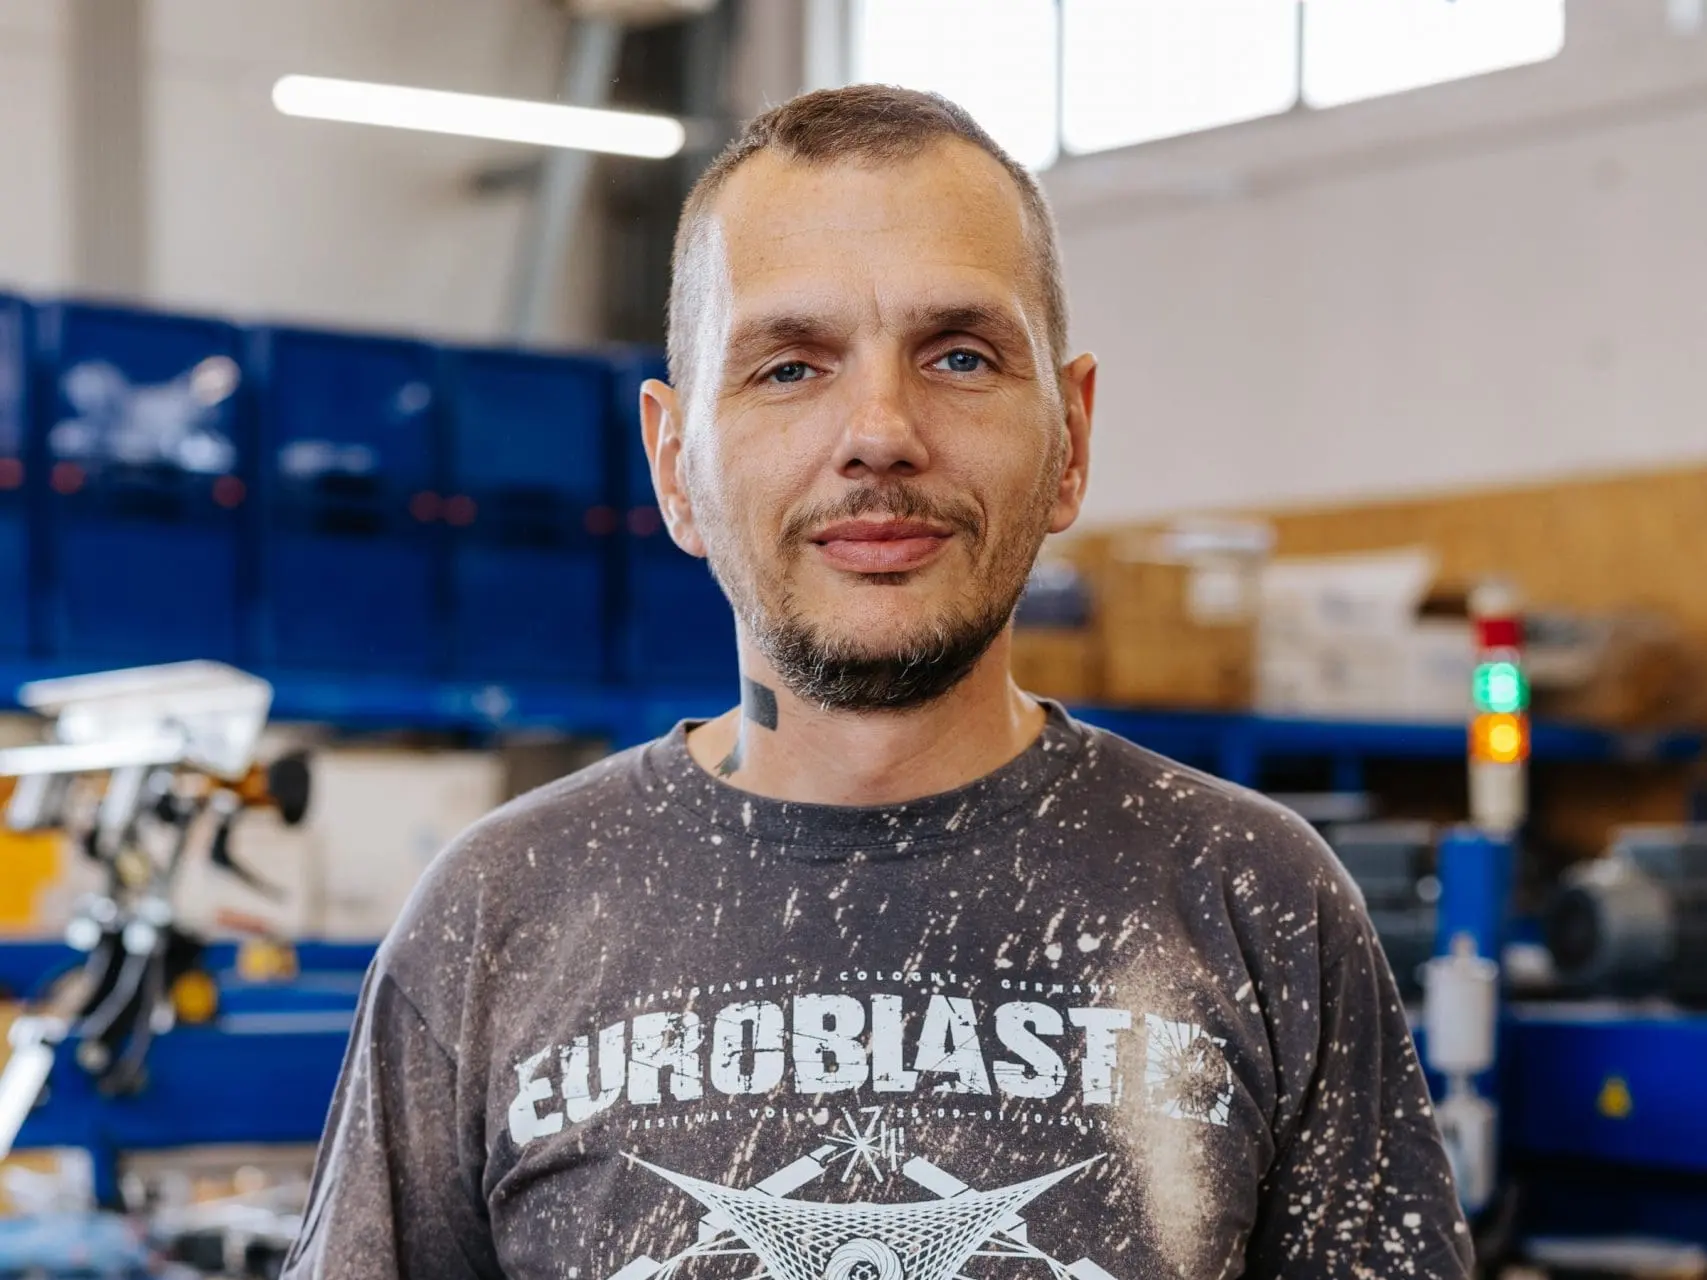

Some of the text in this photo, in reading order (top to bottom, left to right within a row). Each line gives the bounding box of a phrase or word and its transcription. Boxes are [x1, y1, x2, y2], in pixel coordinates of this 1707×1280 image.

[839, 971, 957, 984] COLOGNE
[1000, 979, 1117, 995] GERMANY
[632, 1109, 733, 1131] FESTIVAL
